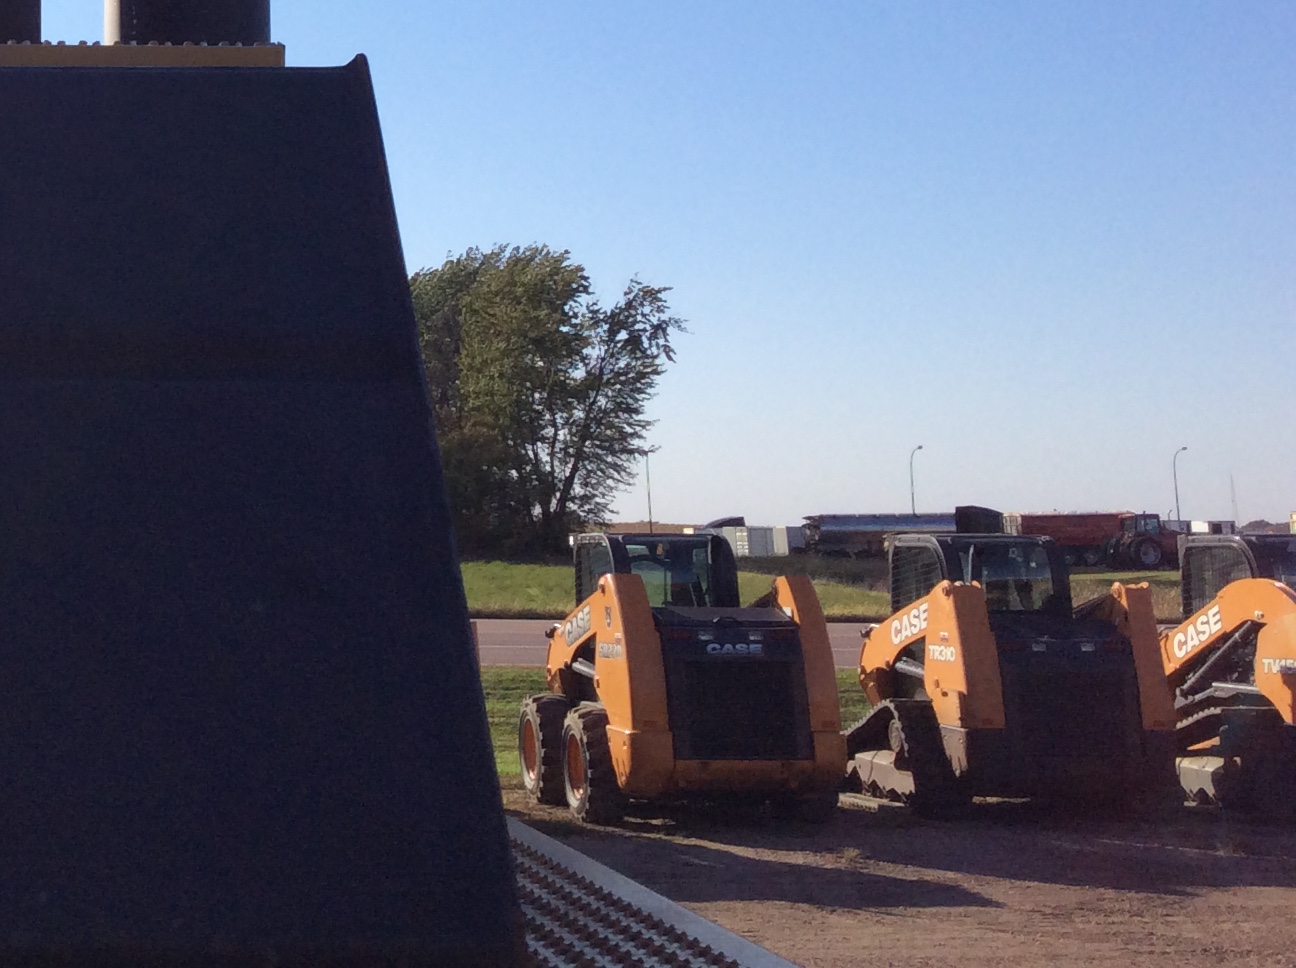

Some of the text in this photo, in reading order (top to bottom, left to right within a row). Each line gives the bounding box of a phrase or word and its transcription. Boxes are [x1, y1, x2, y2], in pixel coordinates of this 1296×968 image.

[565, 604, 591, 646] CASE
[891, 601, 929, 645] CASE
[1173, 605, 1222, 657] CASE
[706, 643, 763, 653] CASE
[928, 644, 956, 662] TR310
[1261, 658, 1296, 673] TV45
